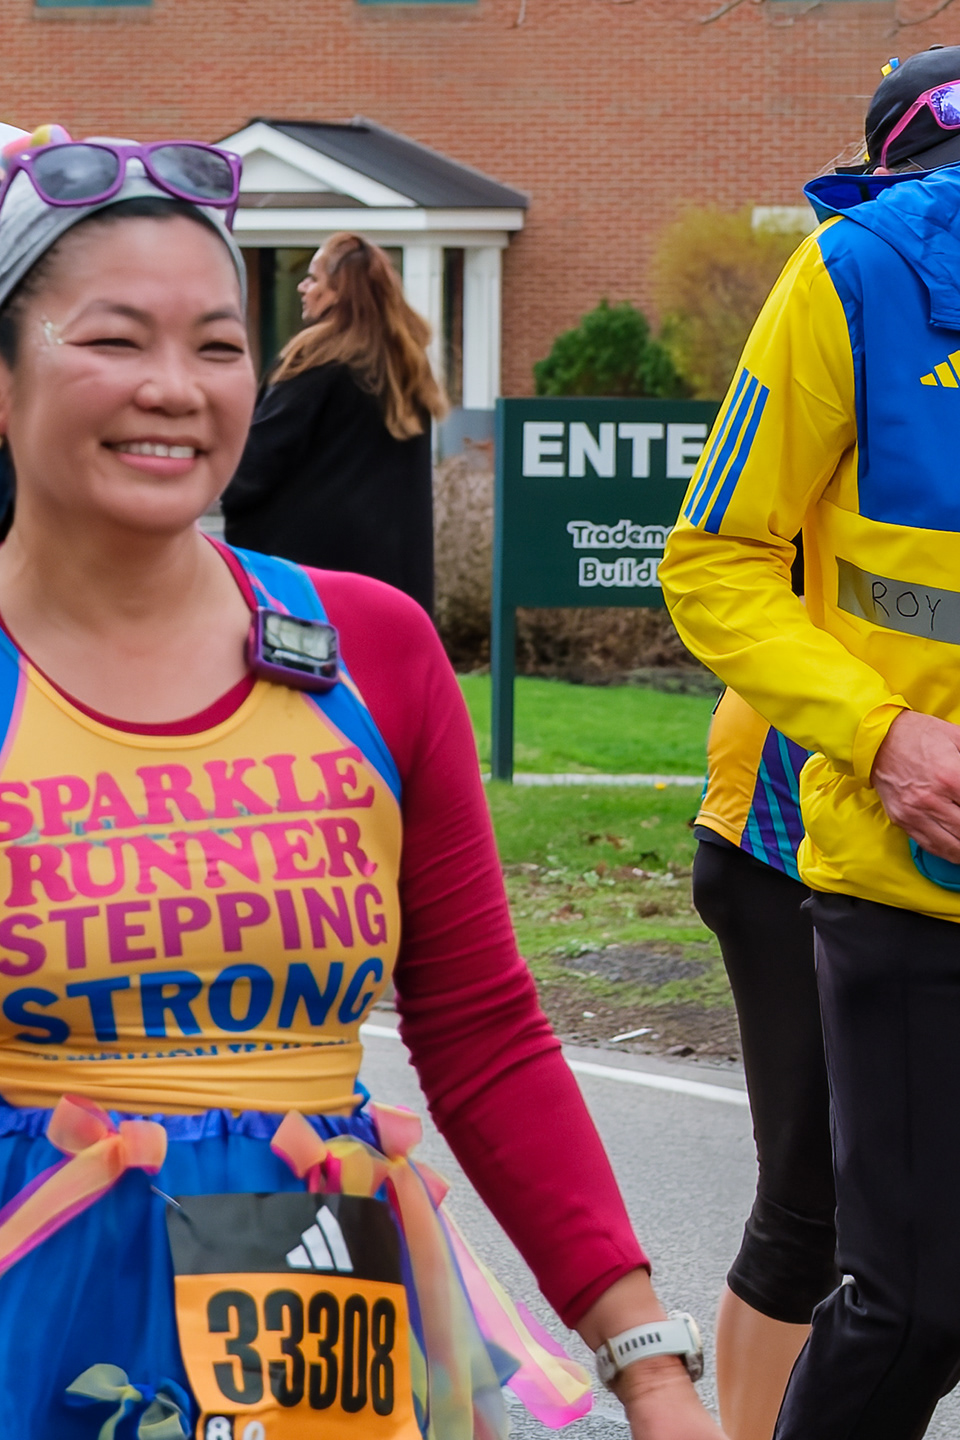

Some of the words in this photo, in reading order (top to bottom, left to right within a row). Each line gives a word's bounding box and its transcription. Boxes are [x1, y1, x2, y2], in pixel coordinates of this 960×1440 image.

[522, 421, 708, 478] ENTE
[570, 521, 667, 547] Tradem
[582, 560, 658, 584] Build
[871, 581, 942, 632] ROY
[3, 817, 379, 908] RUNNER
[2, 957, 384, 1046] STRONG
[206, 1287, 397, 1417] 33308
